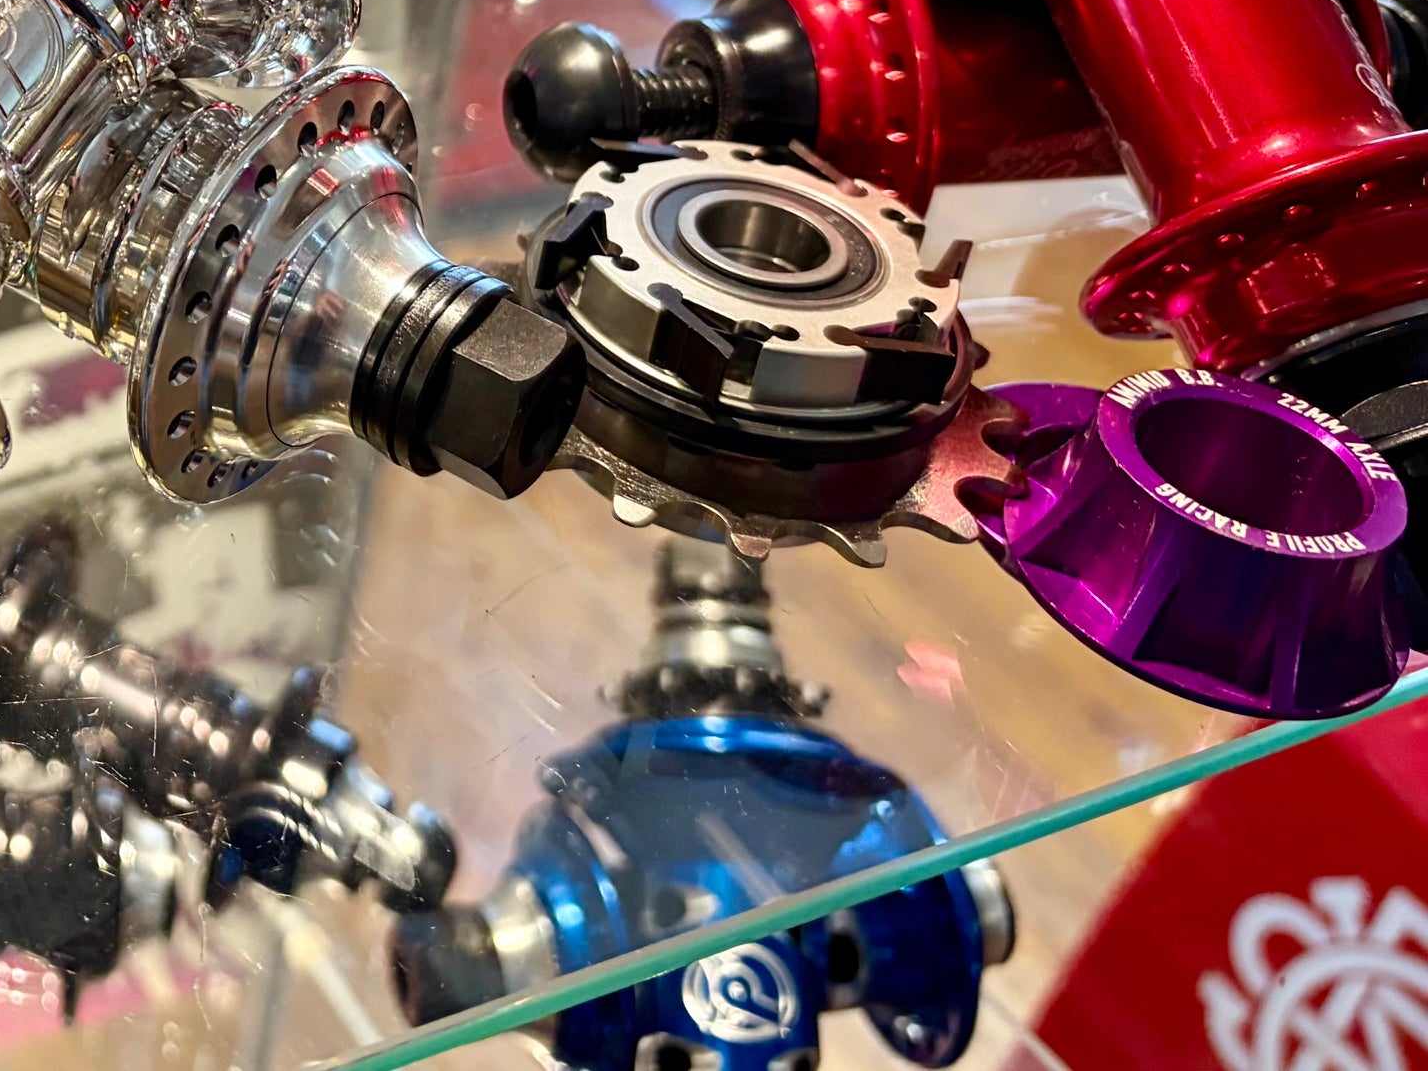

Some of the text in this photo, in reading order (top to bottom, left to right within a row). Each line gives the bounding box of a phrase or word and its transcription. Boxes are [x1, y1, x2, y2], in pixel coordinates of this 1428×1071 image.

[1174, 367, 1224, 388] B.B.
[1276, 392, 1398, 482] 22MM AXLE
[1154, 482, 1367, 555] PROFILE RACING
